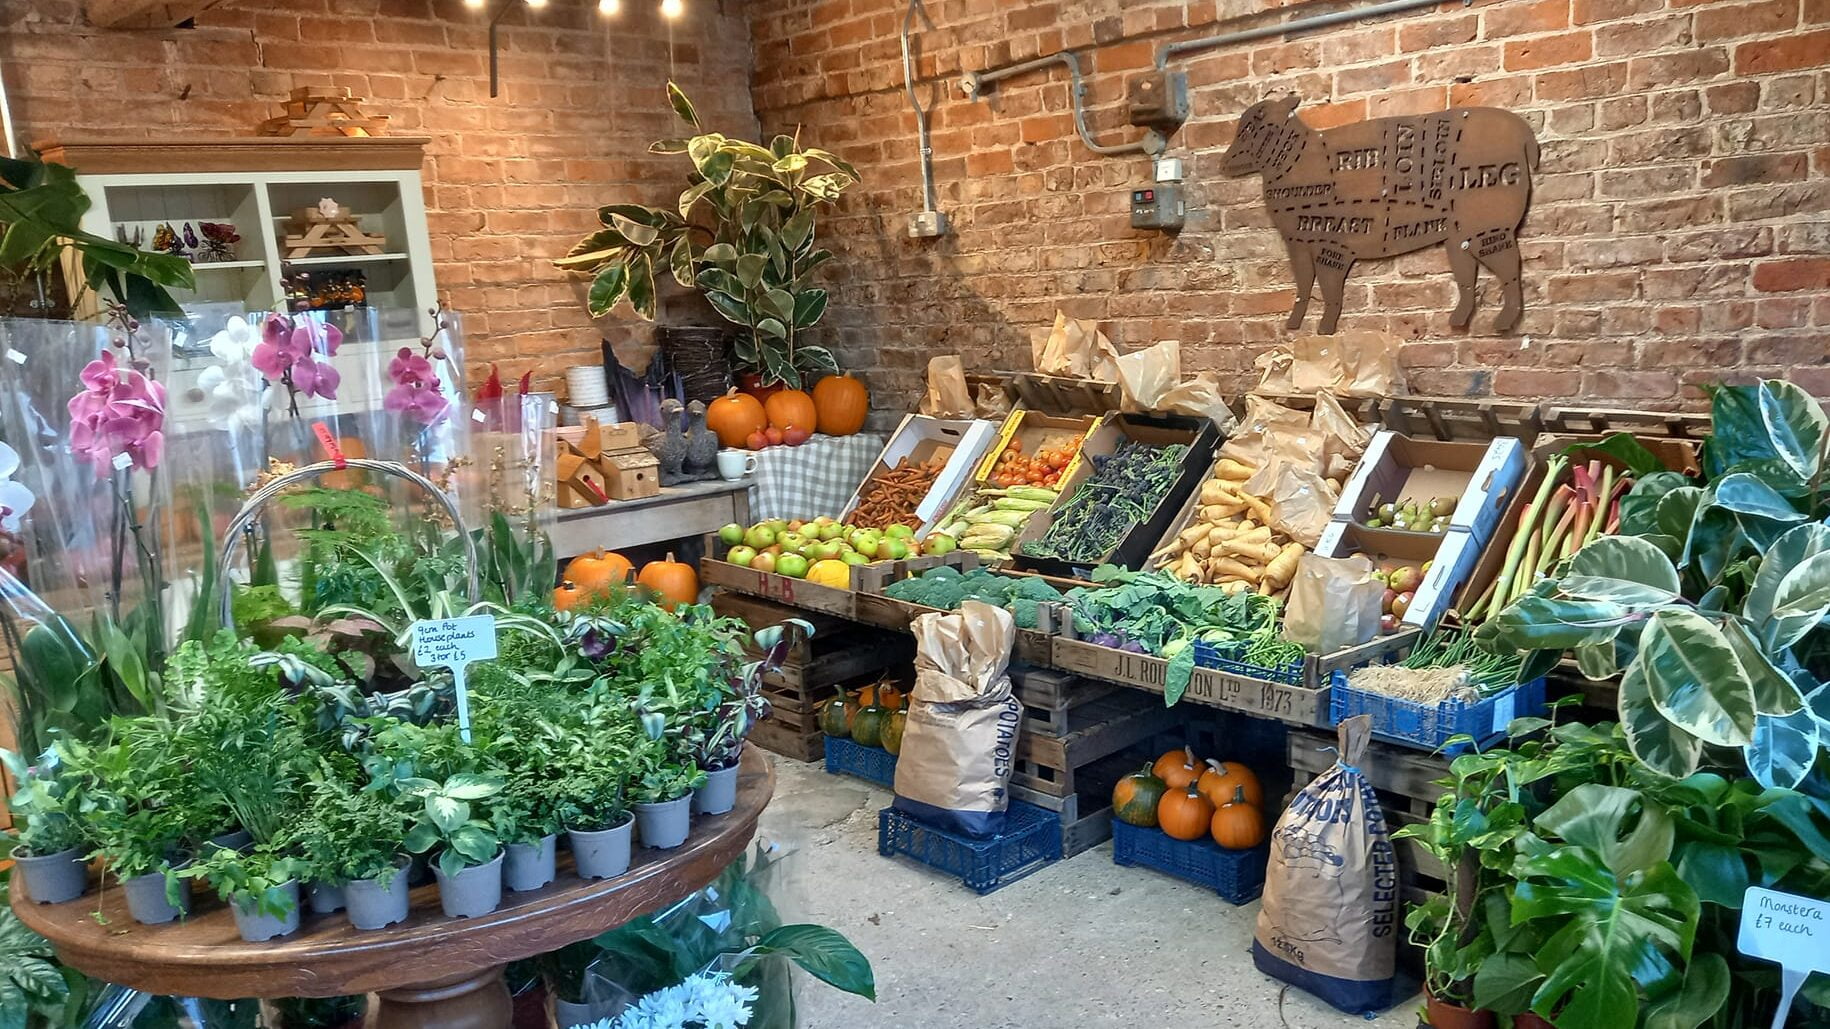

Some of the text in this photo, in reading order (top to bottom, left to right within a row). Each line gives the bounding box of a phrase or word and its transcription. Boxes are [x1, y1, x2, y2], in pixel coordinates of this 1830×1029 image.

[1336, 148, 1380, 172] RIB
[1395, 123, 1415, 193] LOIN
[1458, 162, 1521, 191] LEG
[1265, 184, 1332, 199] SHOULDER
[1297, 215, 1375, 235] BREAST
[1393, 217, 1448, 241] FLANK
[442, 622, 458, 631] Pot
[417, 642, 460, 656] £2 each
[994, 701, 1019, 777] POTATOES
[1372, 840, 1396, 938] SELECTED
[1760, 896, 1823, 920] Monstera
[1755, 913, 1813, 937] £7 each
